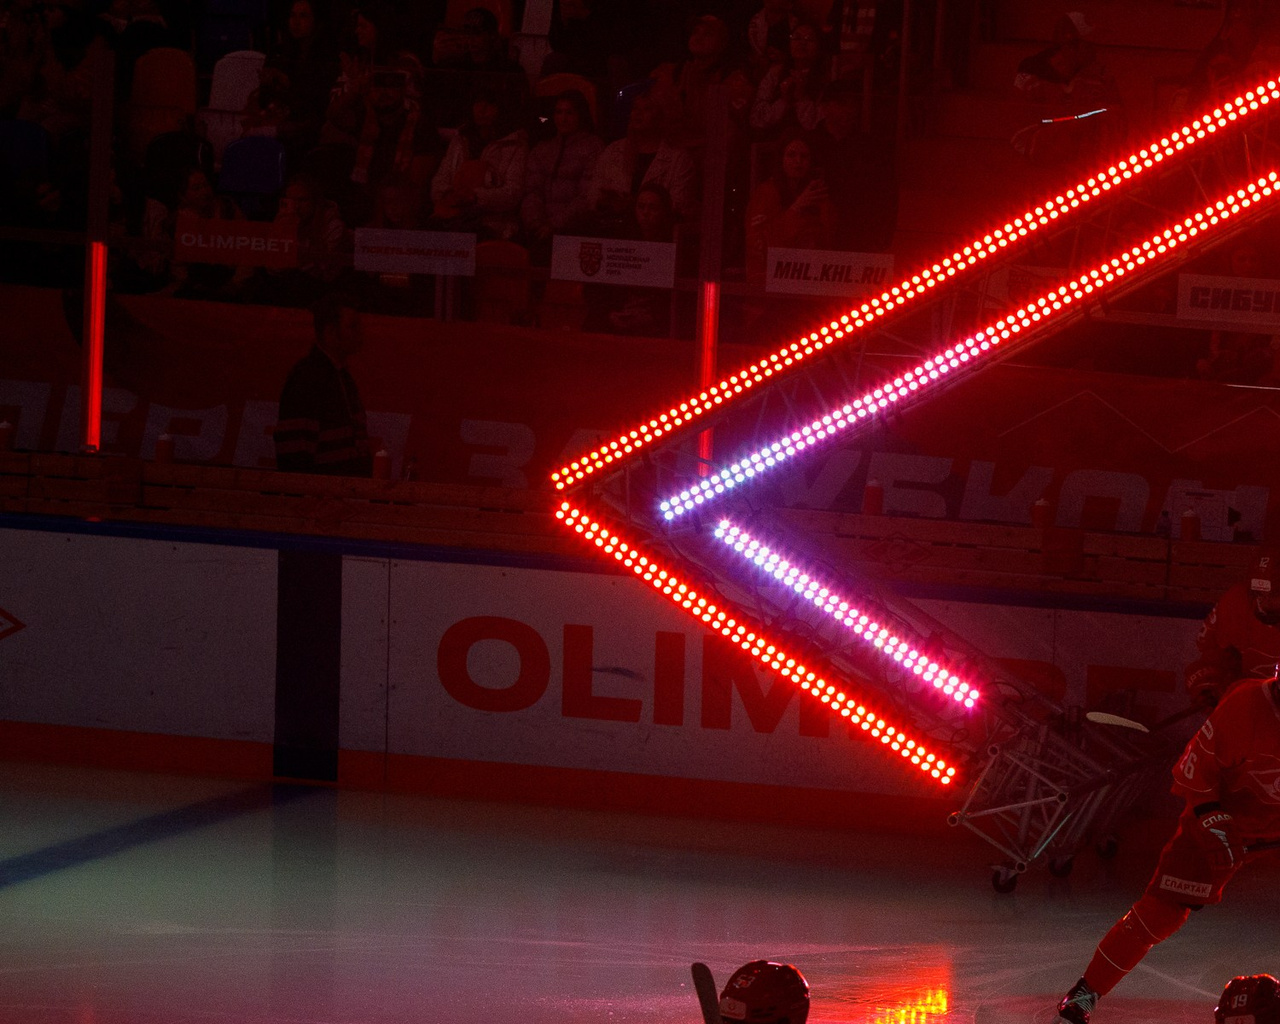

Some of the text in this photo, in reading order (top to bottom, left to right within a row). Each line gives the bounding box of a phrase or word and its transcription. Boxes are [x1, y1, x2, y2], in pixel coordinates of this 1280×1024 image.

[181, 231, 294, 254] OLIMPBET
[774, 261, 887, 284] MHL.KHL.RU
[1258, 556, 1271, 569] 12
[1164, 877, 1208, 895] СПАРТАК
[1231, 993, 1249, 1009] 19
